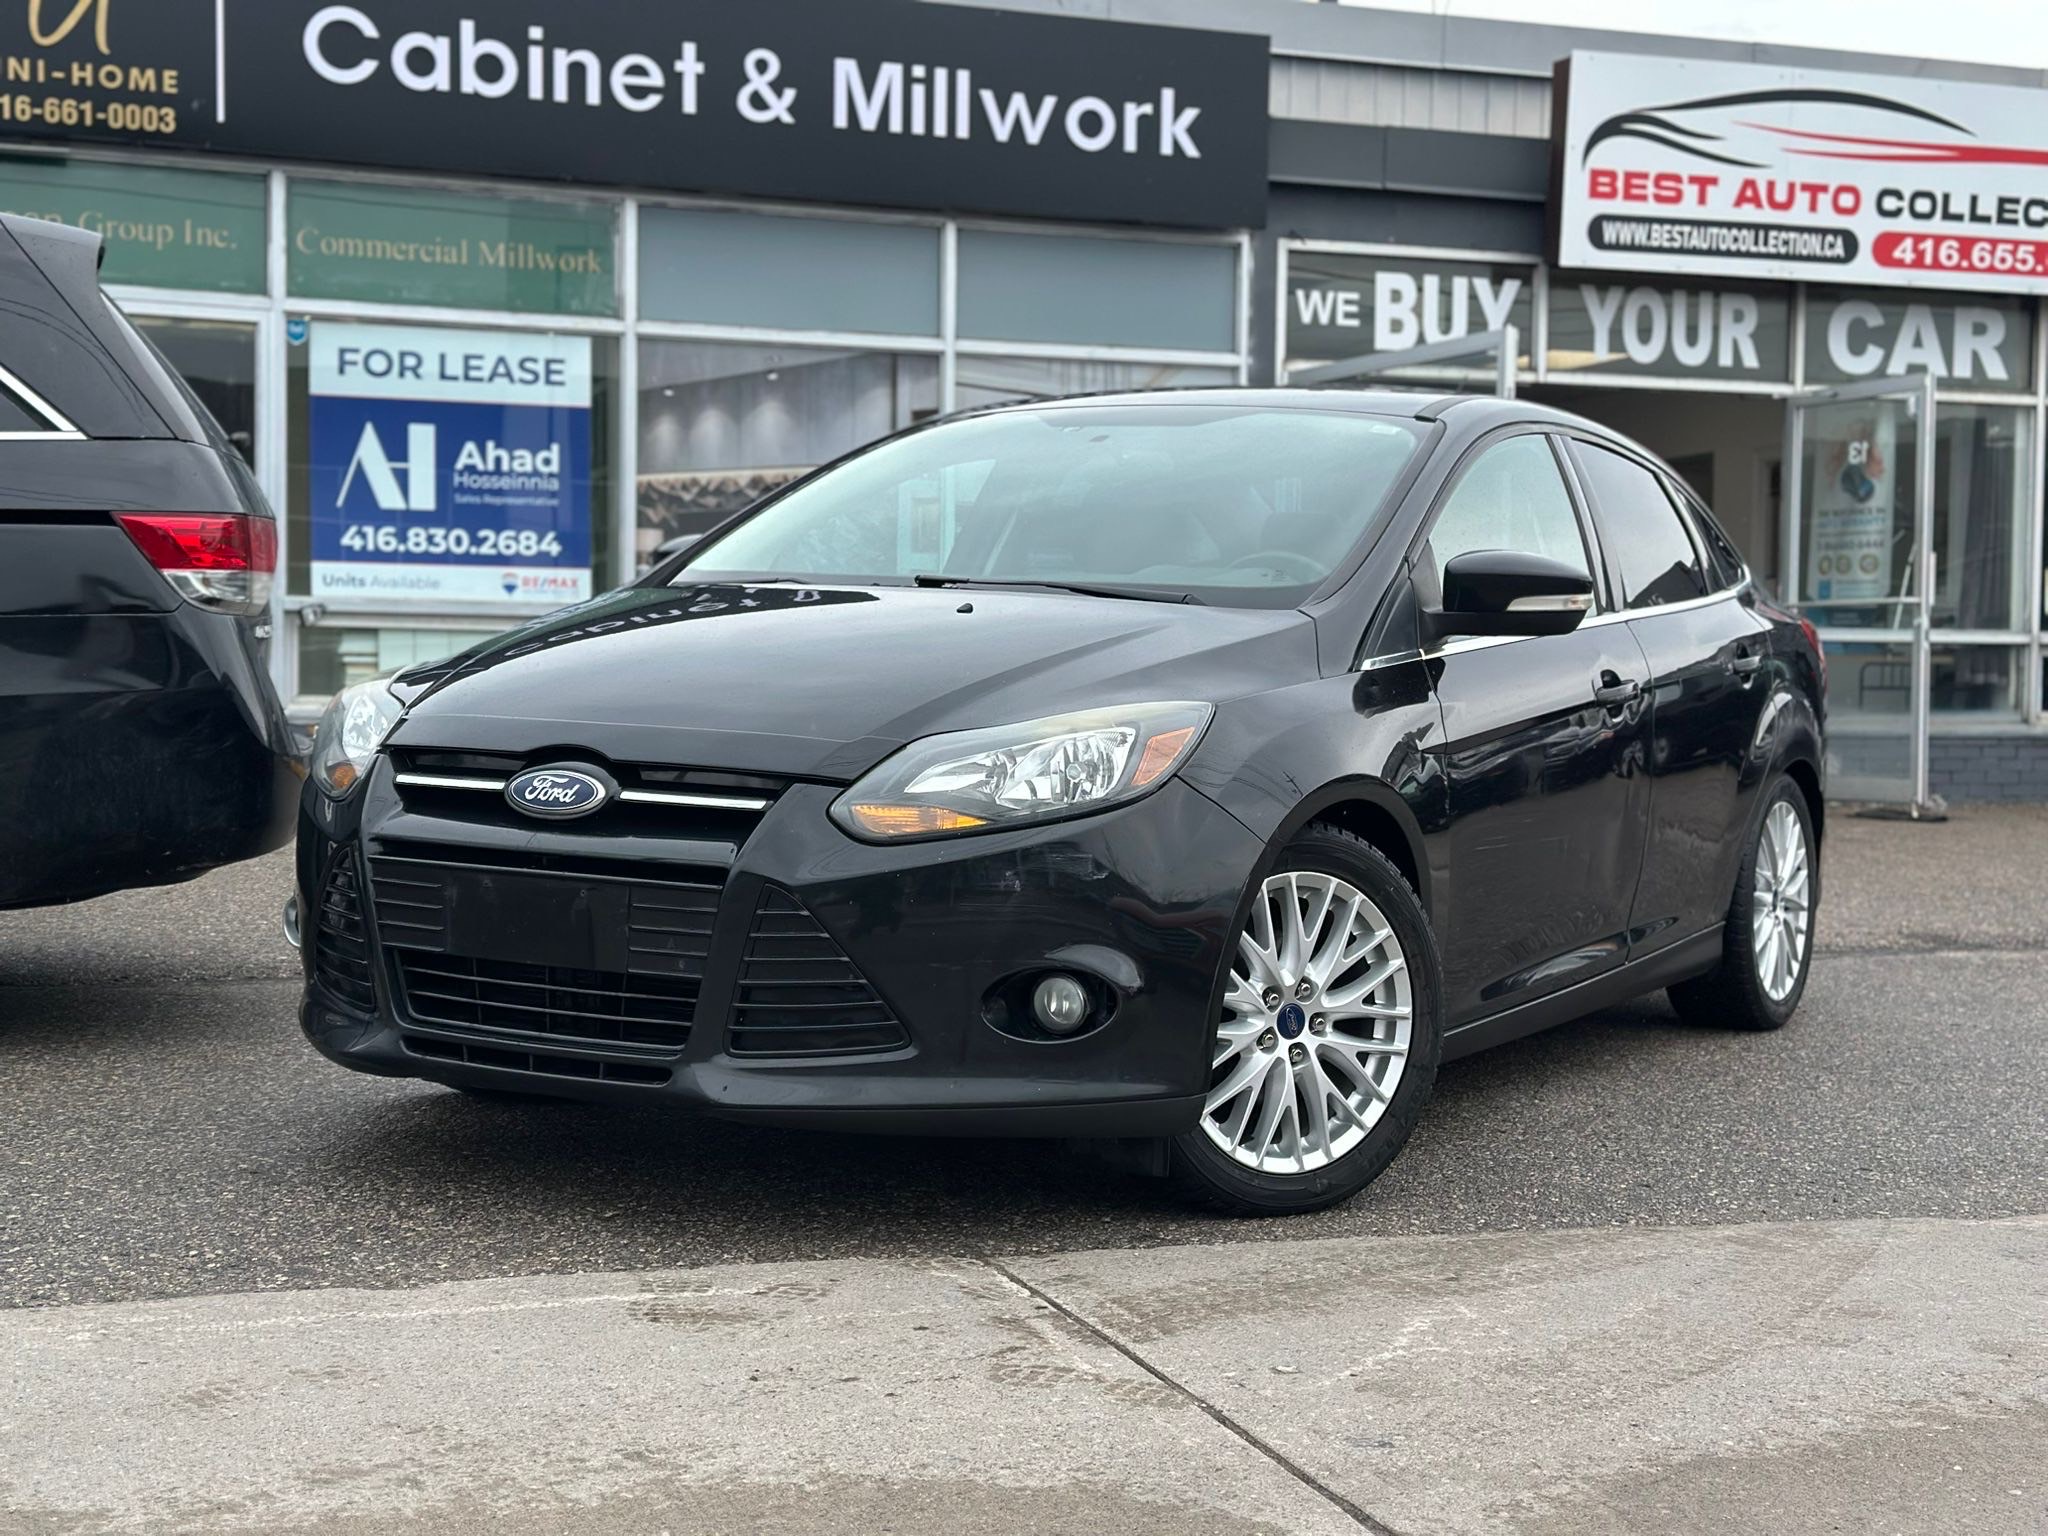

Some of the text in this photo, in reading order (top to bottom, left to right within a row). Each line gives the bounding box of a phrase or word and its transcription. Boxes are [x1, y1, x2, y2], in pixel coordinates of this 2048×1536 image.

[0, 55, 179, 94] NI-HOME
[302, 4, 1202, 159] Cabinet & Millwork
[1588, 168, 1719, 208] BEST
[1733, 177, 1862, 216] AUTO
[78, 210, 175, 250] Group
[184, 218, 238, 250] Inc.
[1602, 220, 1845, 259] WWW.BESTAUTOCOLLECTION.CA
[296, 227, 602, 273] Commercial Millwork
[1296, 270, 2010, 381] WE BUY YOUR CAR
[336, 348, 567, 387] FOR LEASE
[453, 440, 560, 474] Ahad
[453, 471, 560, 491] Hosseinnia
[339, 524, 563, 558] 416.830.2684
[321, 574, 367, 589] Units
[524, 775, 581, 803] Ford
